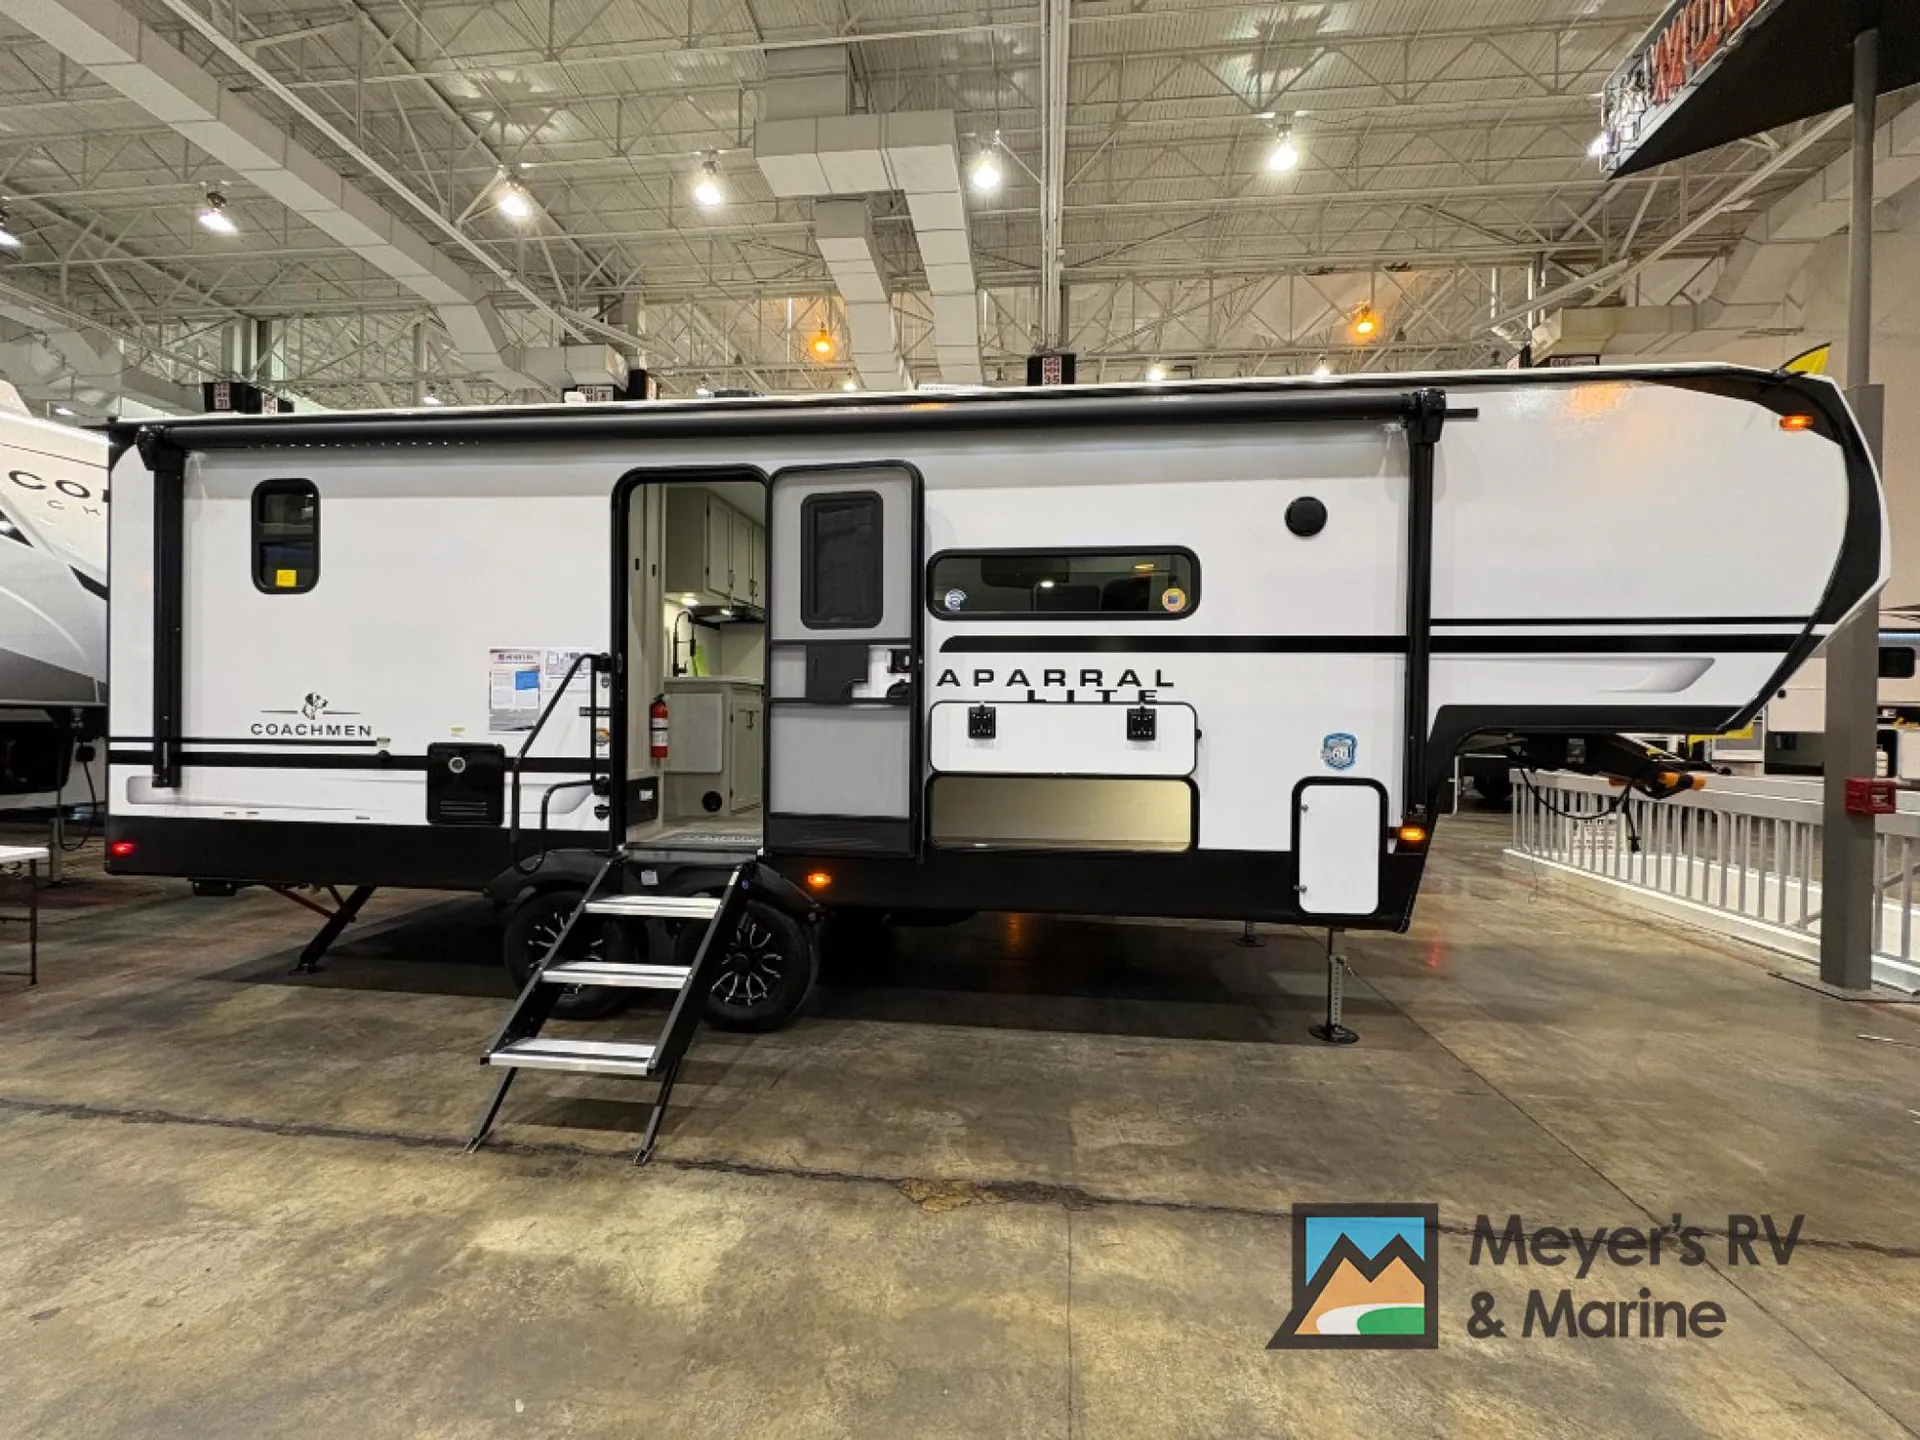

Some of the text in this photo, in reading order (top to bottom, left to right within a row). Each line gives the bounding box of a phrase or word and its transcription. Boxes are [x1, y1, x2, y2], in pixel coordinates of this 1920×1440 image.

[8, 470, 109, 502] CO
[936, 668, 1175, 687] APARRAL
[1026, 689, 1158, 704] LITE
[250, 723, 373, 736] COACHMEN
